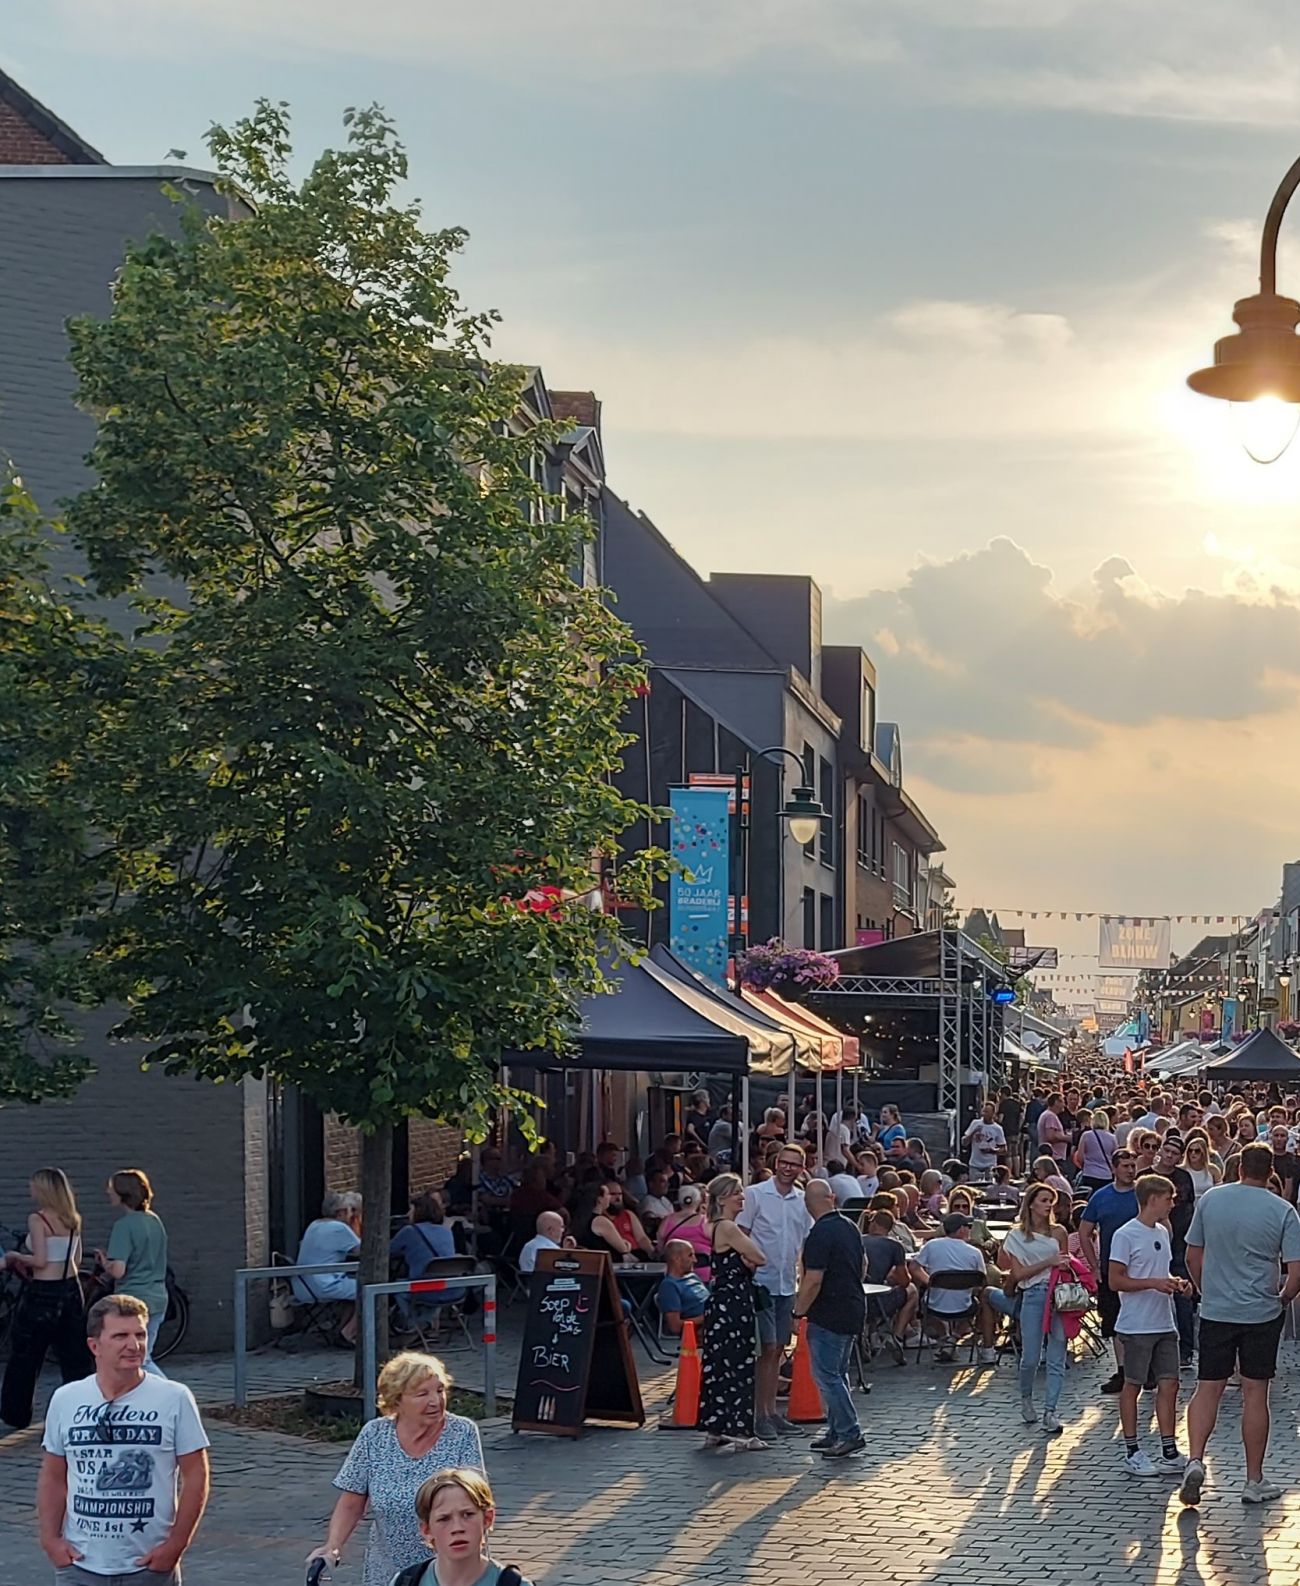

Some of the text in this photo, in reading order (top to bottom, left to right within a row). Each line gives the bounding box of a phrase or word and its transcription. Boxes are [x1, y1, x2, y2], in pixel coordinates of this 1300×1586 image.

[692, 888, 721, 898] JAAR
[1119, 927, 1152, 940] ZONE
[72, 1428, 157, 1442] TRAK DAY
[80, 1448, 113, 1459] STAR
[76, 1460, 109, 1475] USA
[76, 1499, 151, 1515] CHAMPIONSHIP
